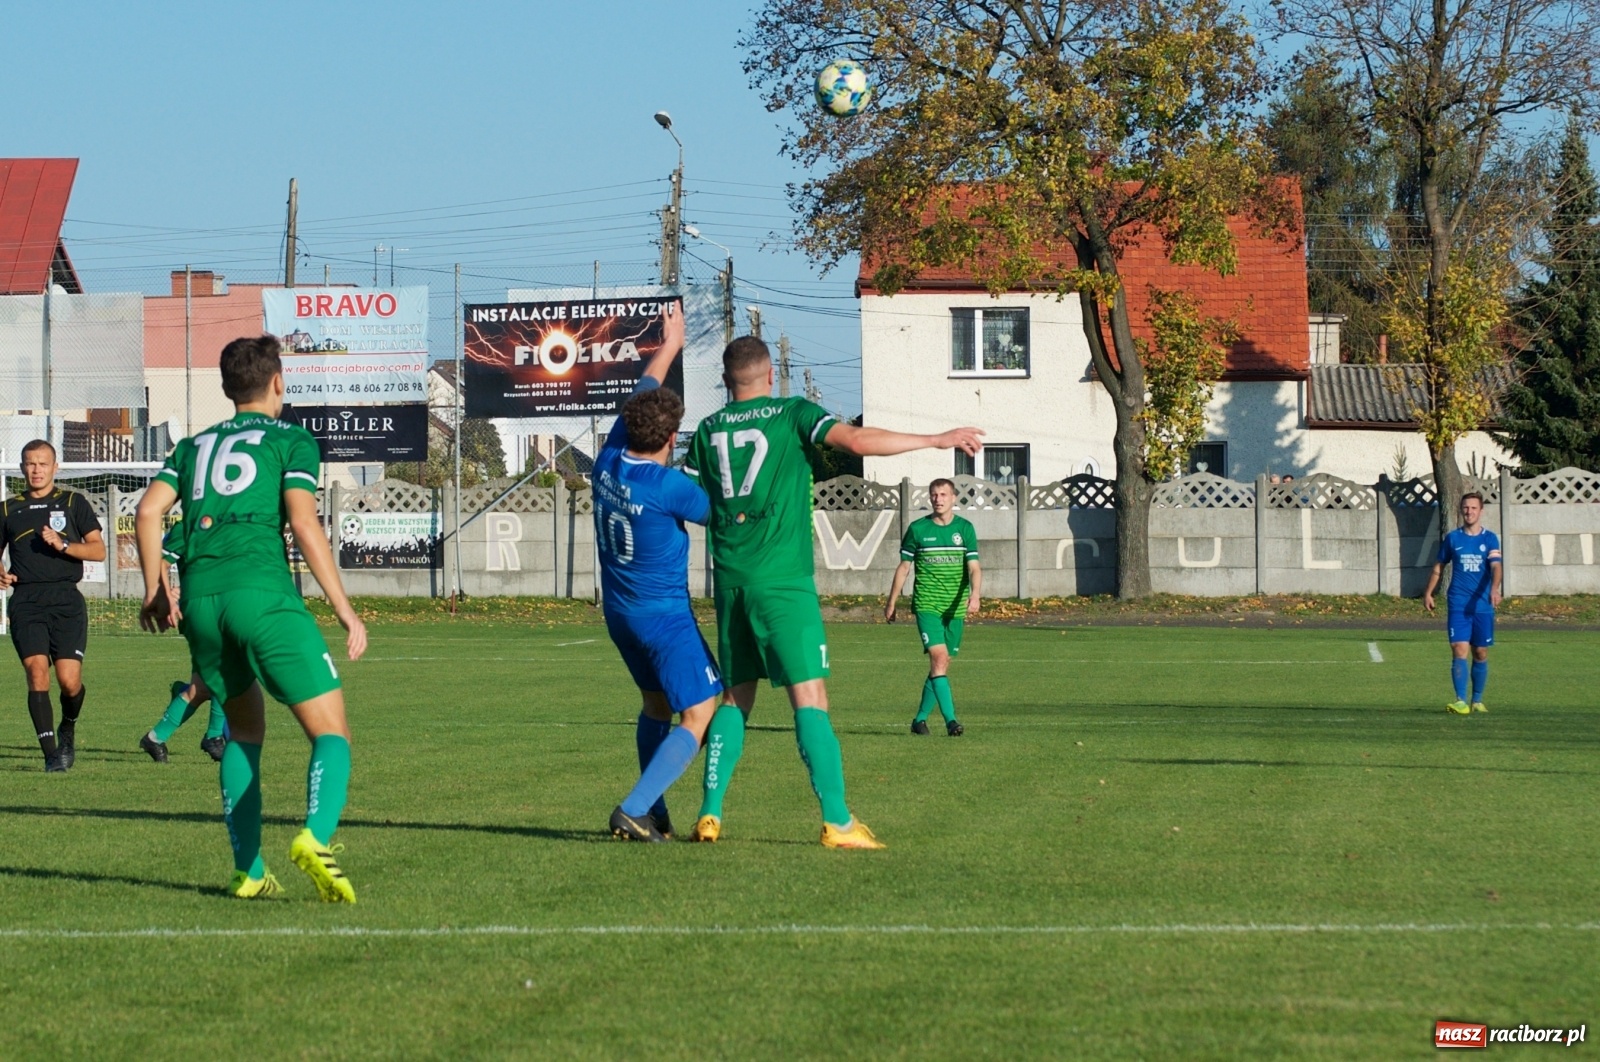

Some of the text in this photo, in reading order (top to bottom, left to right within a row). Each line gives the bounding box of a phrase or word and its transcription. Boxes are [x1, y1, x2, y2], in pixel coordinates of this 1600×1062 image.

[295, 293, 398, 318] BRAVO
[472, 306, 567, 323] INSTALACJE
[320, 323, 424, 336] DOM WESELNY
[320, 339, 425, 352] RESTAURACJA
[286, 384, 303, 394] 602
[306, 384, 322, 393] 744
[349, 384, 361, 393] 48
[364, 383, 381, 393] 606
[384, 382, 395, 392] 27
[398, 382, 410, 392] 08
[413, 382, 423, 392] 98
[535, 401, 616, 412] www.fiolka.com.pl
[191, 429, 267, 501] 16
[710, 428, 769, 499] 17
[365, 518, 386, 526] JEDEN
[387, 518, 396, 526] ZA
[365, 527, 397, 535] WSZYSCY
[398, 527, 407, 535] ZA
